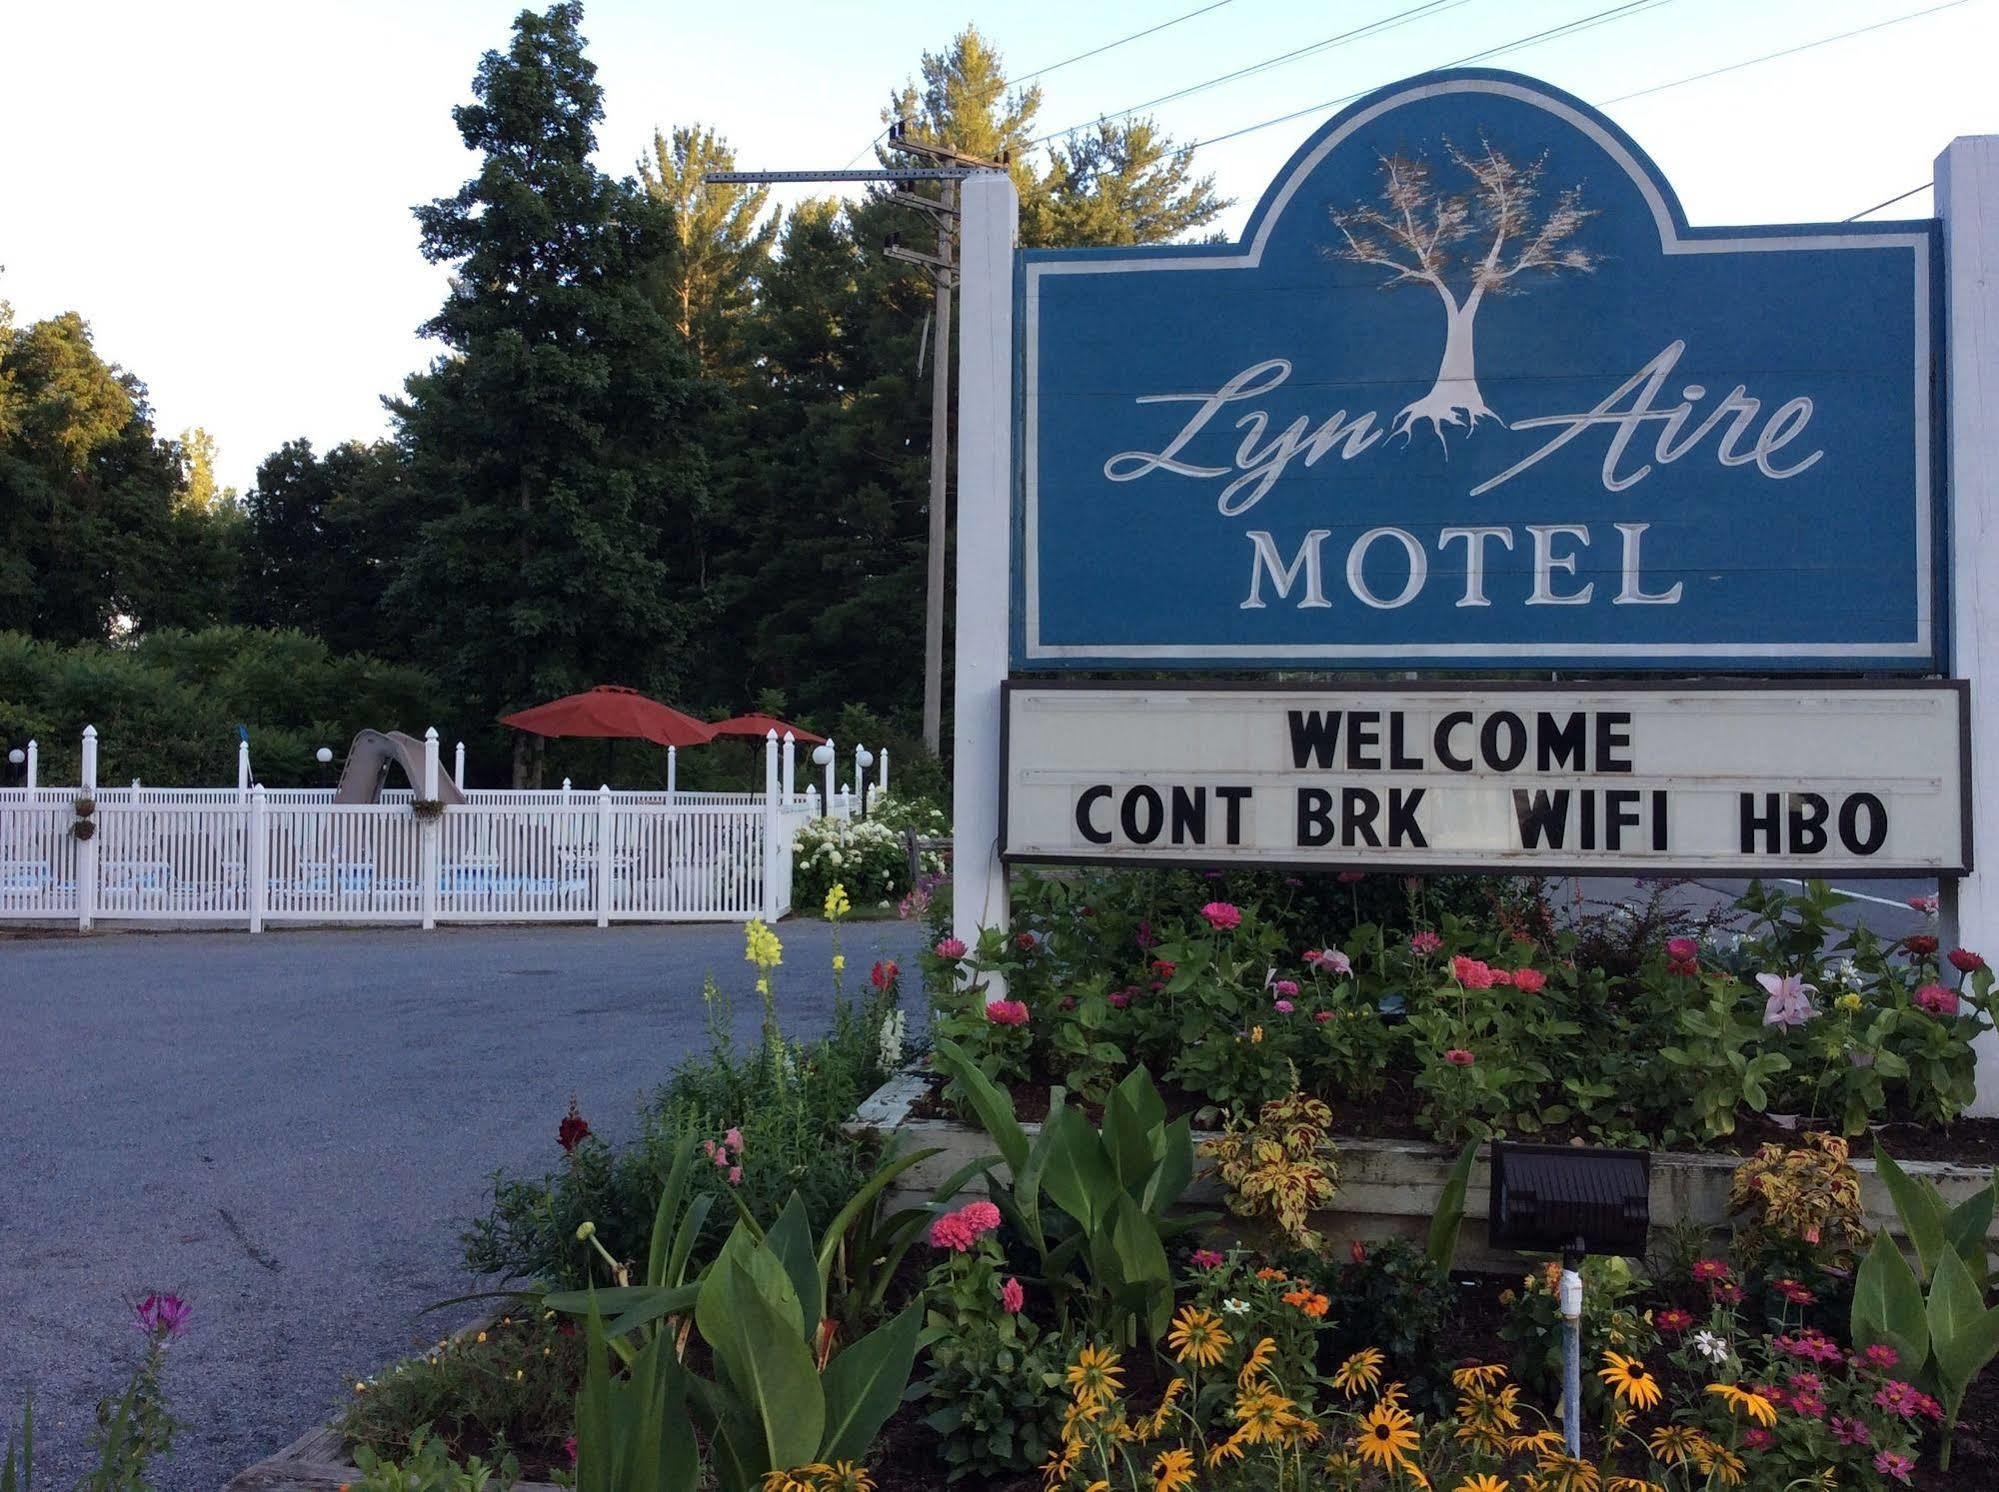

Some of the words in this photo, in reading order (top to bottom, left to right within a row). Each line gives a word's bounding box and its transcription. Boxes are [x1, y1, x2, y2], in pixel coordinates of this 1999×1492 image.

[1104, 358, 1384, 517] Lyn
[1470, 340, 1824, 497] Aire
[1240, 523, 1684, 610] MOTEL
[1288, 711, 1633, 773] WELCOME
[1075, 785, 1253, 846] CONT
[1297, 788, 1428, 848] BRK
[1513, 788, 1668, 851] WIFI
[1740, 792, 1888, 855] HBO
